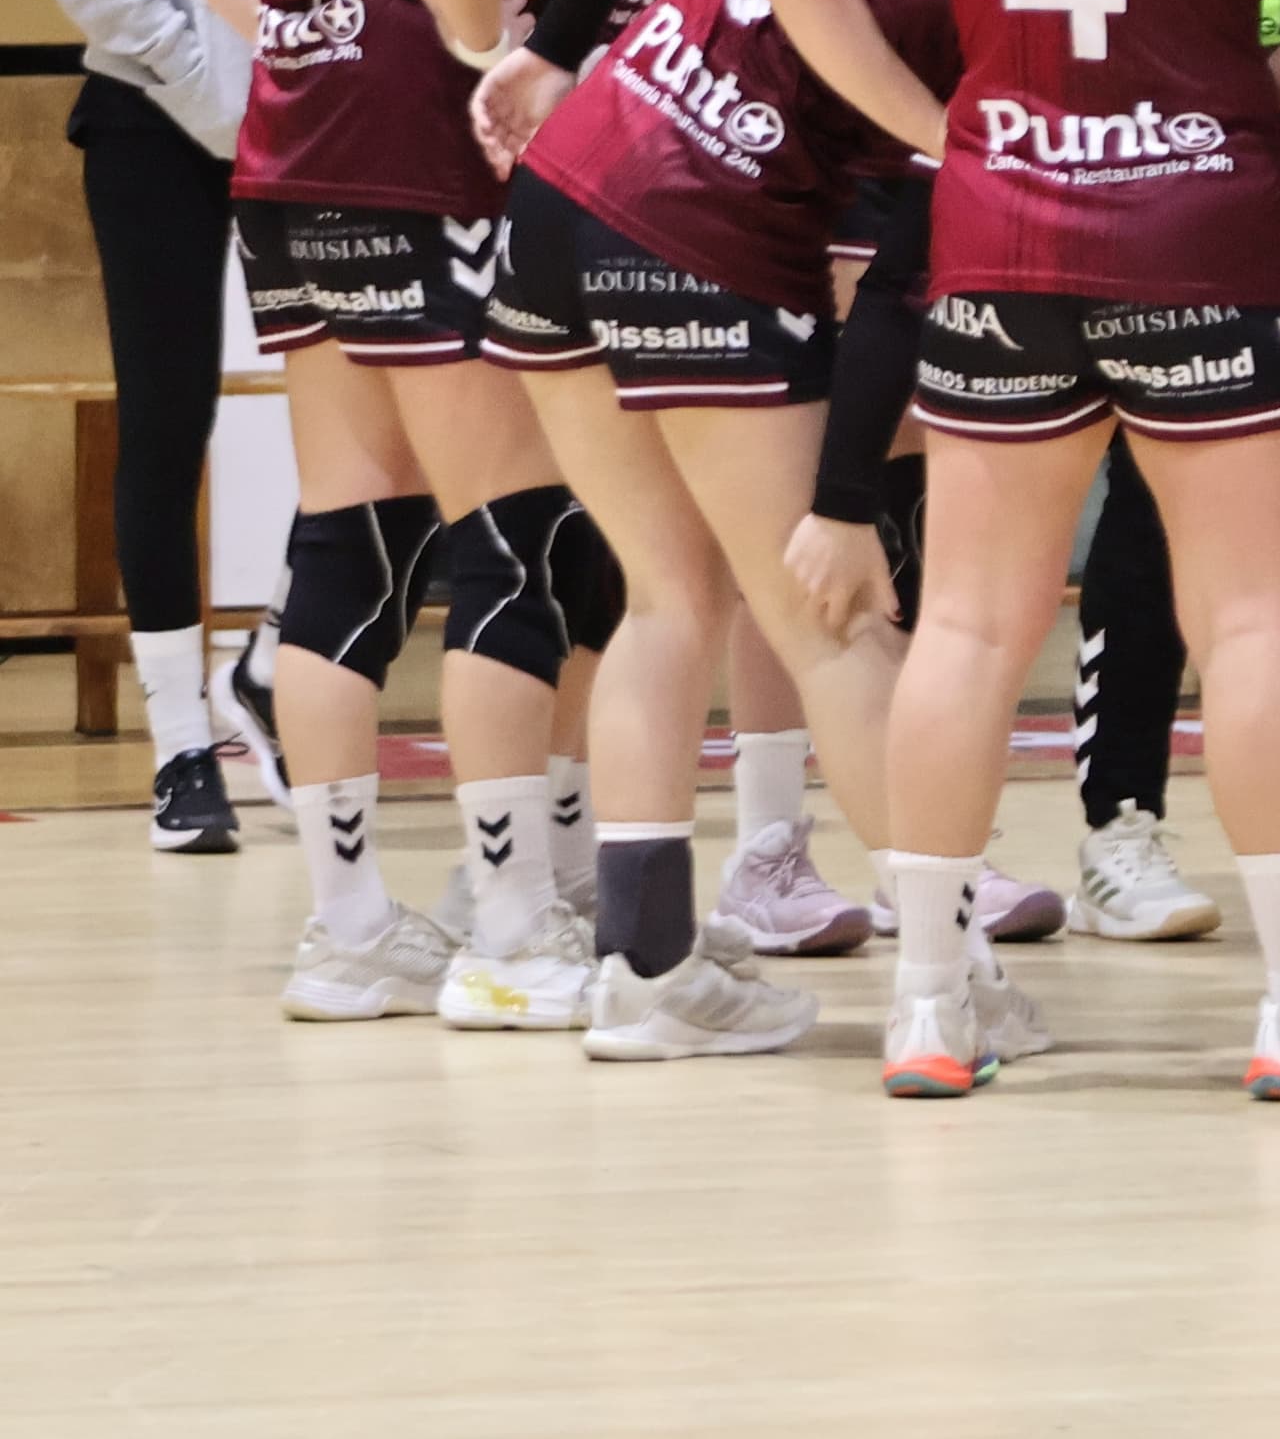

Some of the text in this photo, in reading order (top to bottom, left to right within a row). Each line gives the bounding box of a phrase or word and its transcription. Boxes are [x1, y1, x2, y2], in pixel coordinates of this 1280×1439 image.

[1073, 158, 1190, 186] Restaurante
[1194, 152, 1235, 173] 24h
[1082, 304, 1242, 340] LOUISIANA
[1097, 346, 1255, 389] Dissalud
